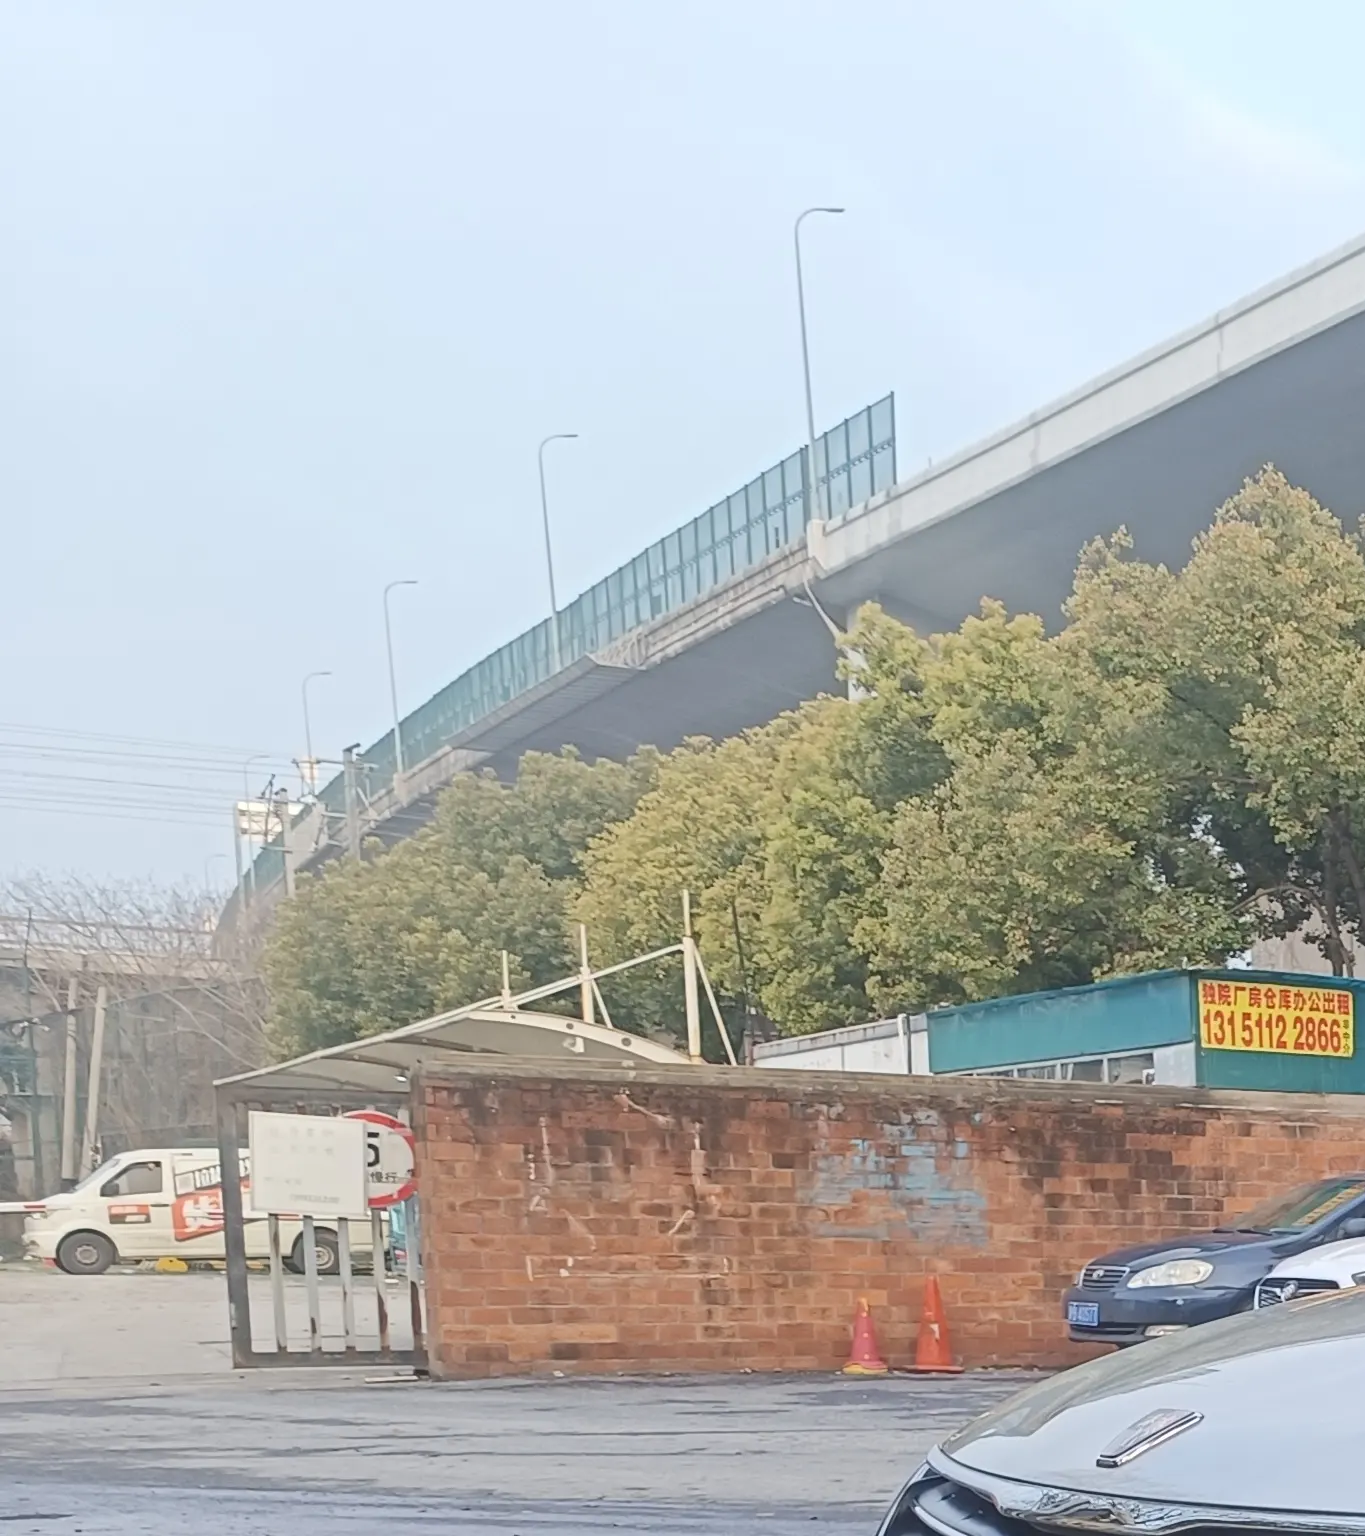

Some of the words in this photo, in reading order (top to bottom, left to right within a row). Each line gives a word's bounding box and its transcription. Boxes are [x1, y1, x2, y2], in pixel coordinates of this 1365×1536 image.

[1202, 983, 1350, 1016] 独院厂房仓库办公出租
